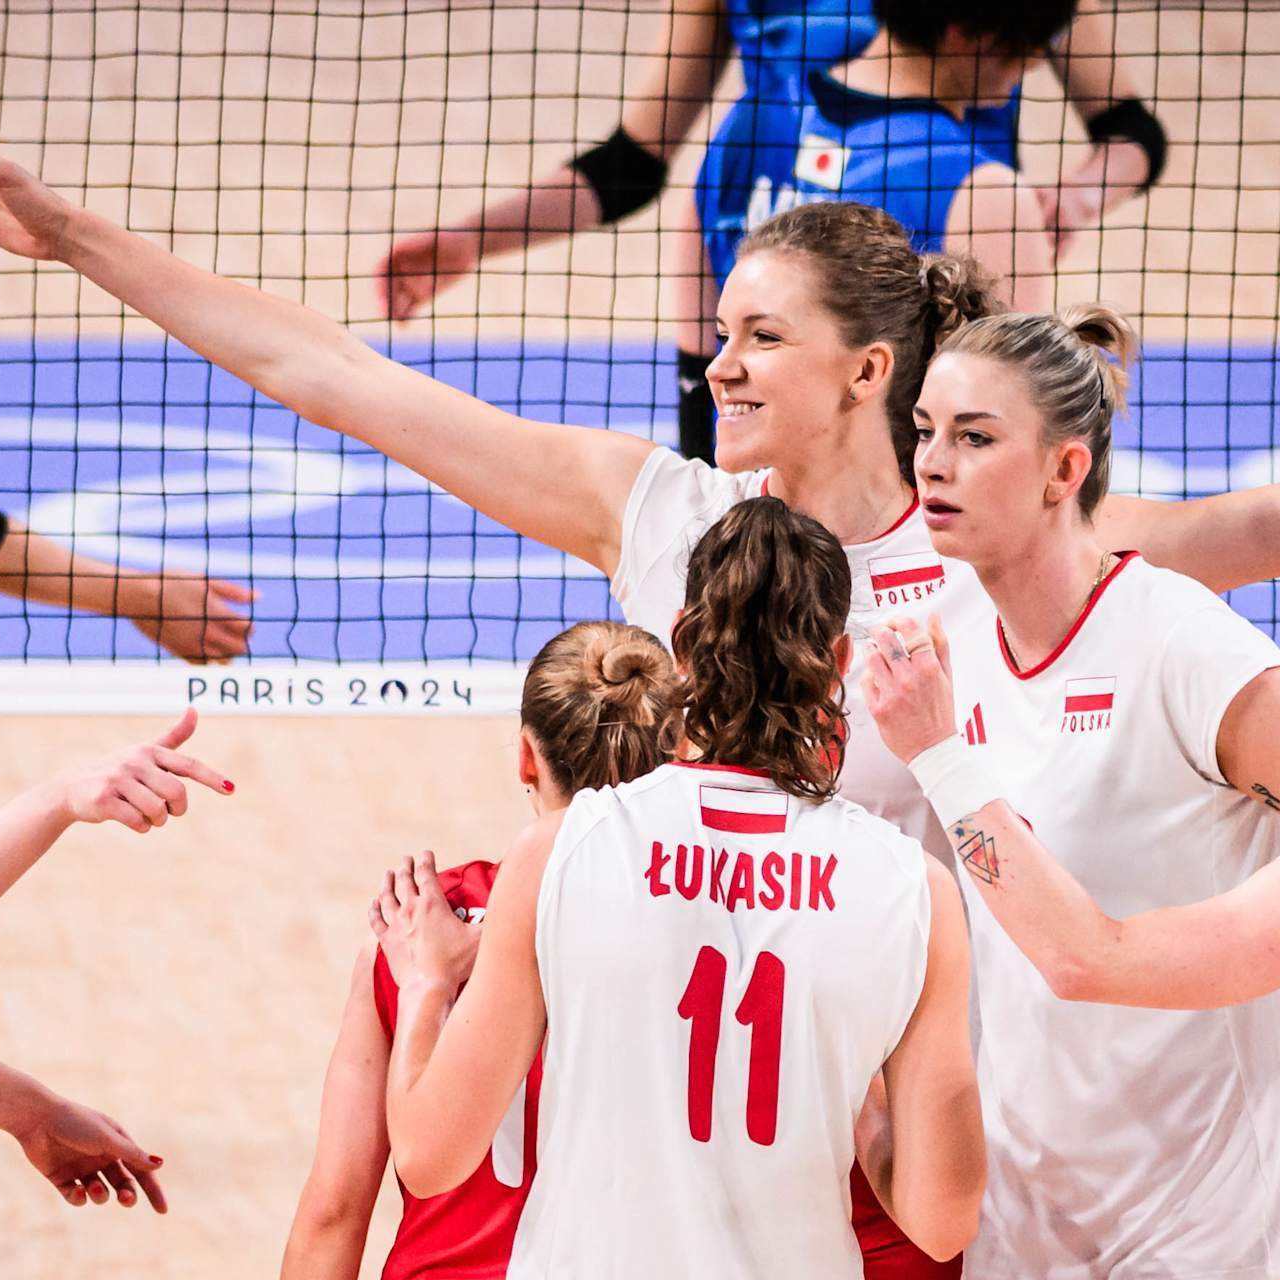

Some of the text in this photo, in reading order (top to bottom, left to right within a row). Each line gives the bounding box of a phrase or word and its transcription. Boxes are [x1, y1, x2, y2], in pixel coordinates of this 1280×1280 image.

[1061, 712, 1111, 733] POLSKA
[644, 841, 839, 914] ŁUKASIK
[677, 945, 786, 1147] 11
